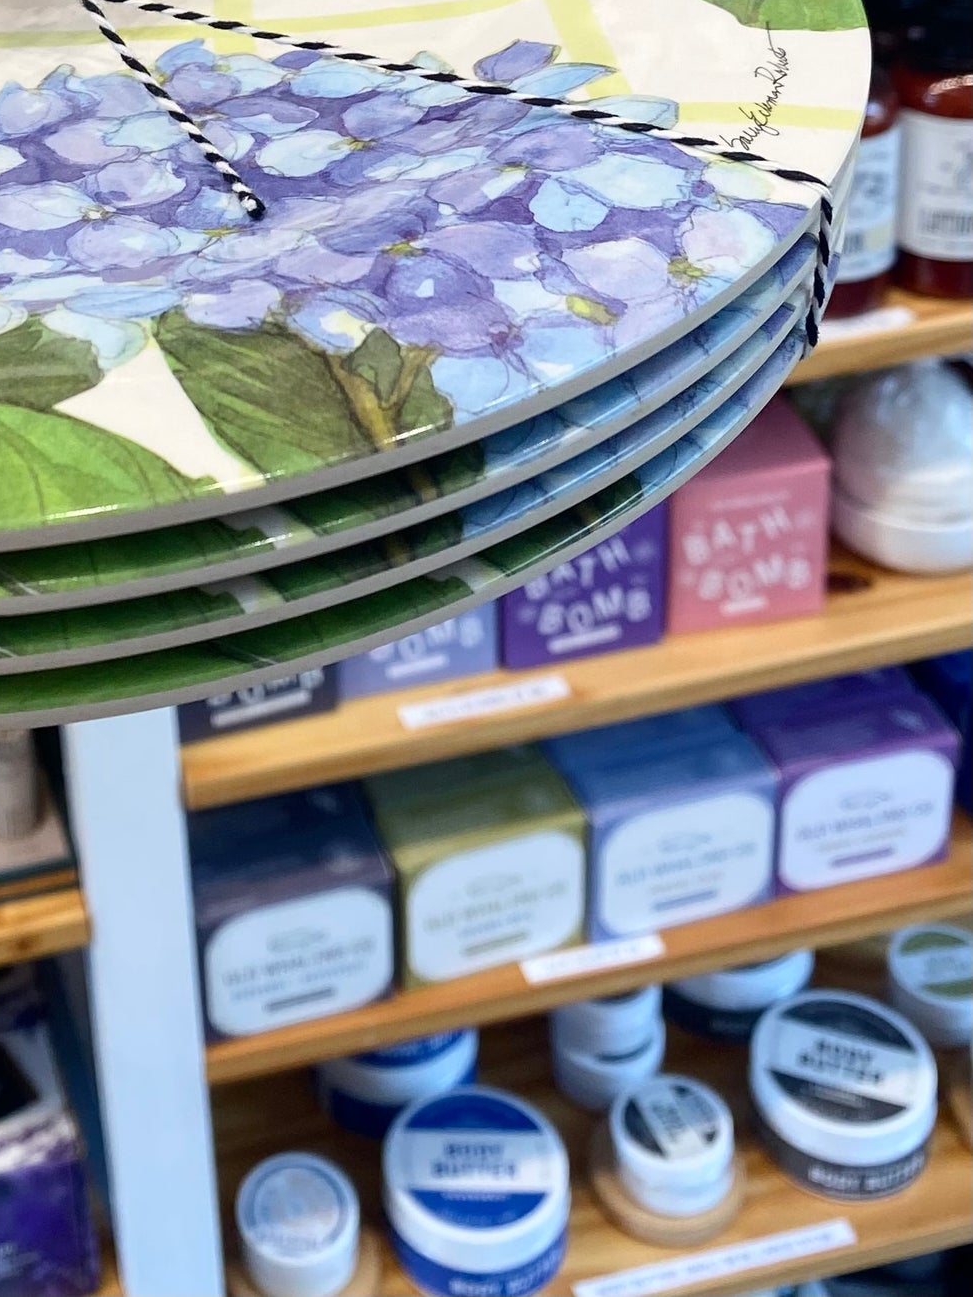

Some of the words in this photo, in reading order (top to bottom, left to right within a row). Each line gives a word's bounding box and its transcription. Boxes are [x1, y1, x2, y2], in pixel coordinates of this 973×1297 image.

[682, 505, 793, 566] BATH
[698, 552, 811, 602] BOMB
[537, 584, 652, 635] BOMB
[815, 1039, 874, 1064] BODY
[796, 1052, 885, 1086] BUTTER
[444, 1142, 504, 1157] BODY
[431, 1160, 517, 1181] BUTTER
